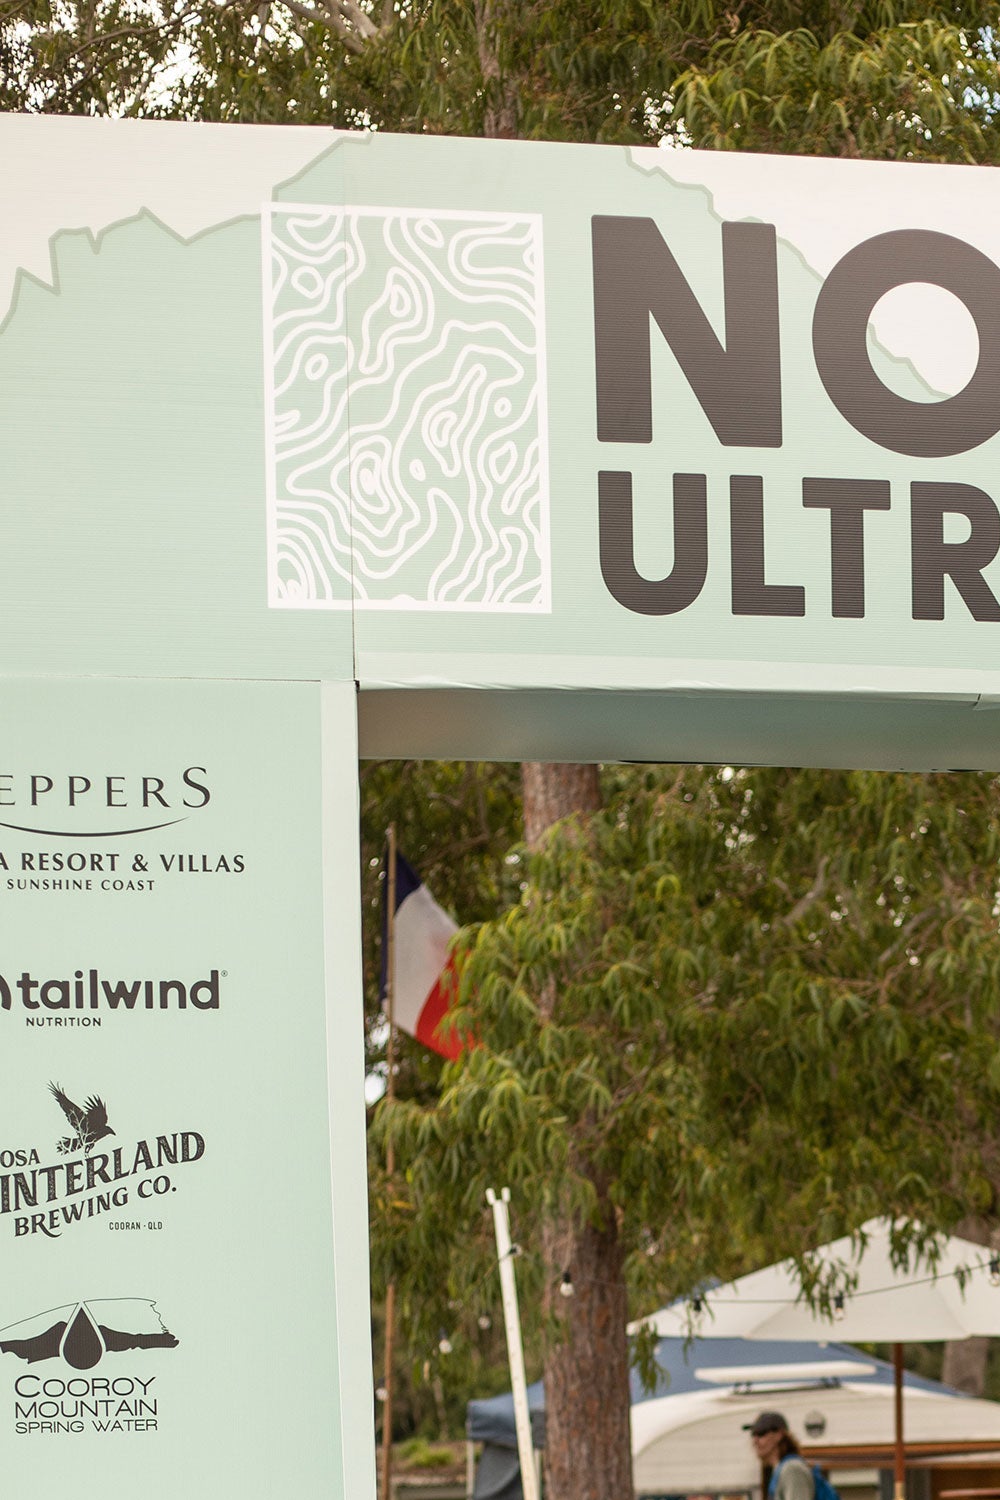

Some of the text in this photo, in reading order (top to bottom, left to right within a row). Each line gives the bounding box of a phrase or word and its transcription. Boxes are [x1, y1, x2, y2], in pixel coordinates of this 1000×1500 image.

[21, 853, 120, 872] RESORT
[132, 853, 149, 872] &
[160, 854, 245, 873] VILLAS
[7, 879, 155, 891] SUNSHINE COAST
[16, 969, 220, 1010] tailwind
[26, 1017, 102, 1027] NUTRITION
[0, 1149, 41, 1168] OSA
[14, 1175, 177, 1238] BREWING CO.
[109, 1221, 163, 1231] COORAN QLD
[15, 1399, 158, 1419] MOUNTAIN
[15, 1419, 158, 1434] SPRING WATER
